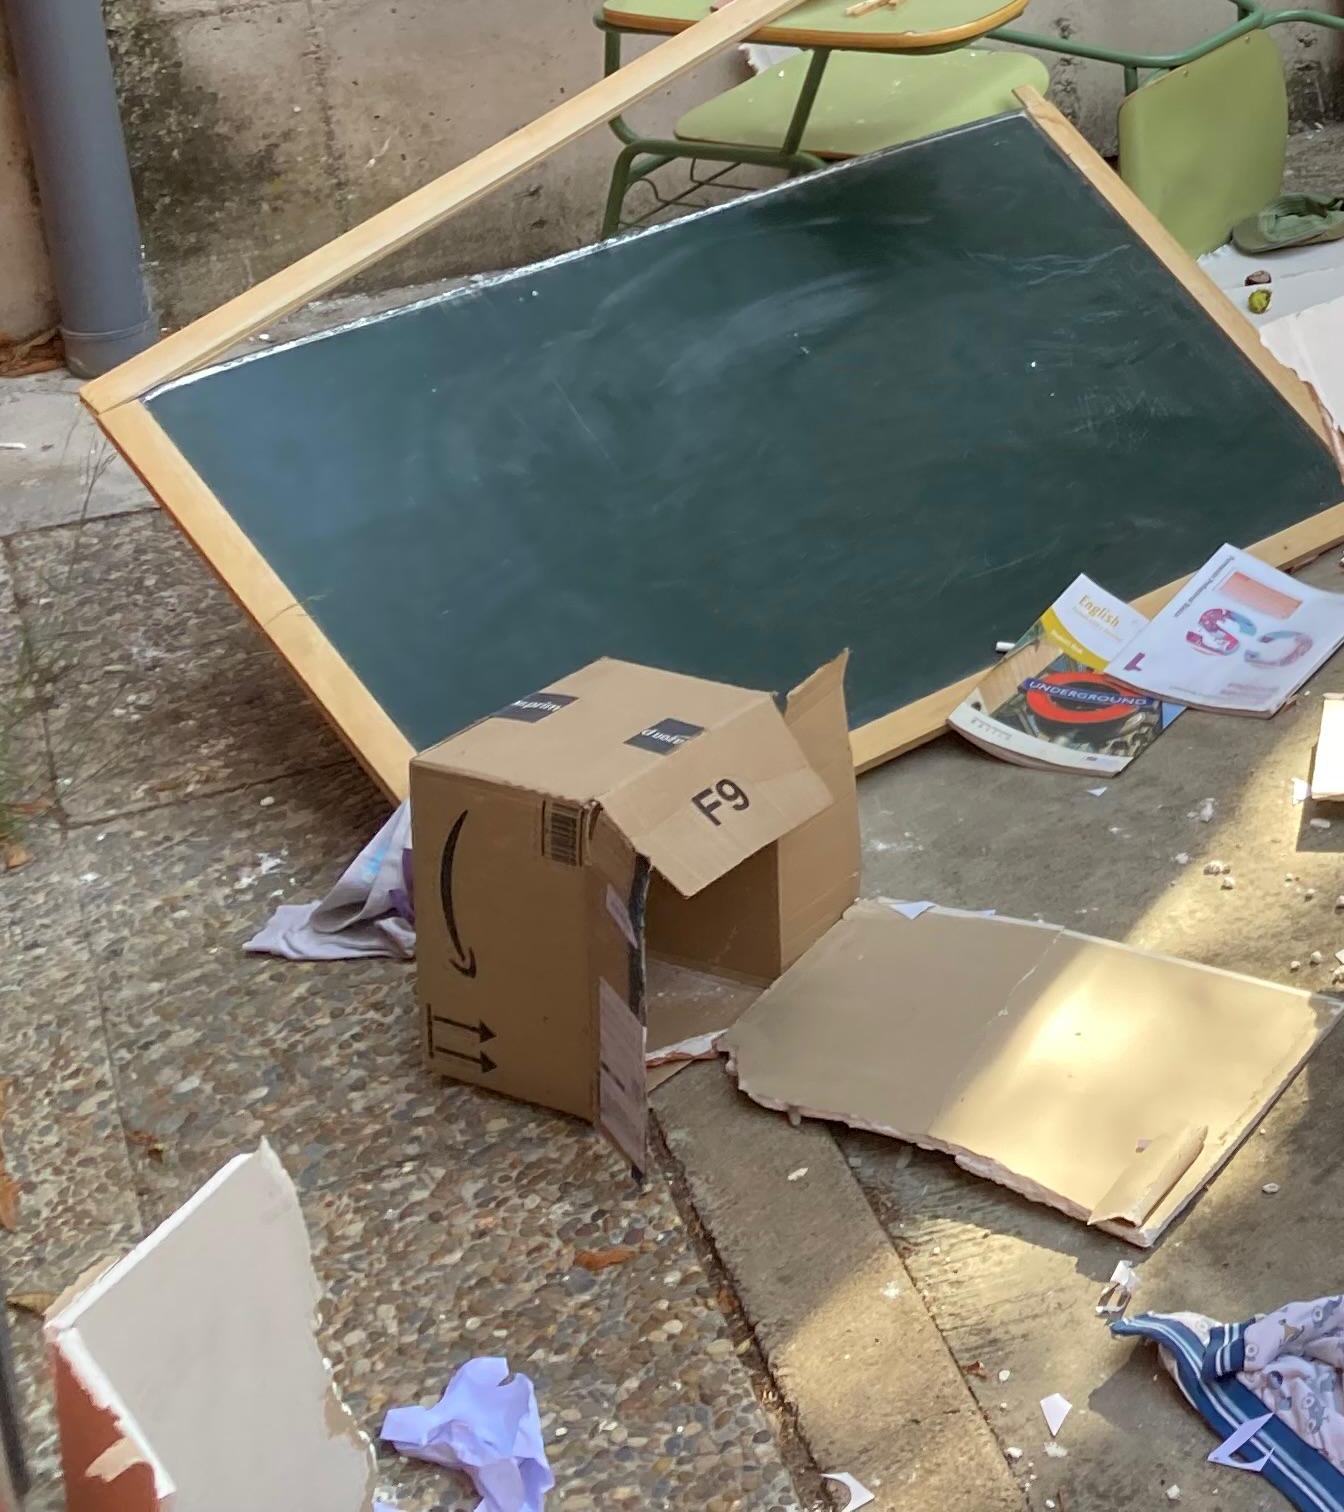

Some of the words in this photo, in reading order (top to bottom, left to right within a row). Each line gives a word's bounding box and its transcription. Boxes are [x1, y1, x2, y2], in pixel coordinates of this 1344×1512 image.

[1078, 594, 1120, 628] English
[1029, 681, 1148, 705] UNDERGROUND
[691, 778, 750, 826] F9
